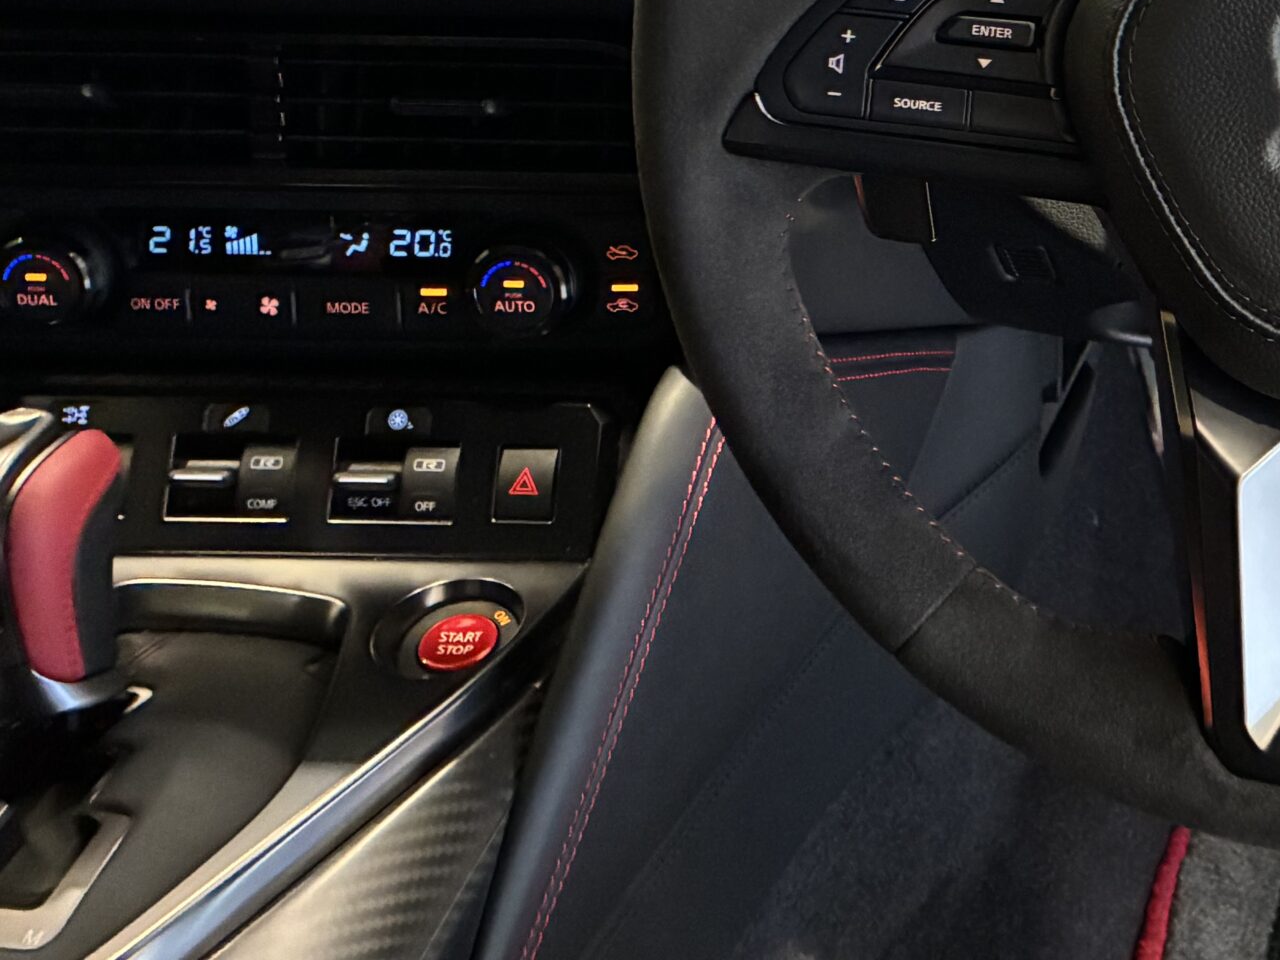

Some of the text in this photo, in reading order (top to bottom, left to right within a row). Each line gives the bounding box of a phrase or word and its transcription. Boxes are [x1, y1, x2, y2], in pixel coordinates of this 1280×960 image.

[971, 24, 1013, 39] ENTER
[893, 97, 943, 112] SOURCE
[17, 294, 57, 306] DUAL
[130, 298, 181, 311] ON OFF
[326, 302, 369, 314] MODE
[418, 302, 447, 315] A/C
[494, 301, 535, 313] AUTO
[247, 499, 277, 510] COMP
[371, 497, 391, 508] OFF
[415, 501, 436, 512] OFF
[494, 610, 511, 626] ON
[438, 631, 483, 643] START
[436, 644, 475, 656] STOP
